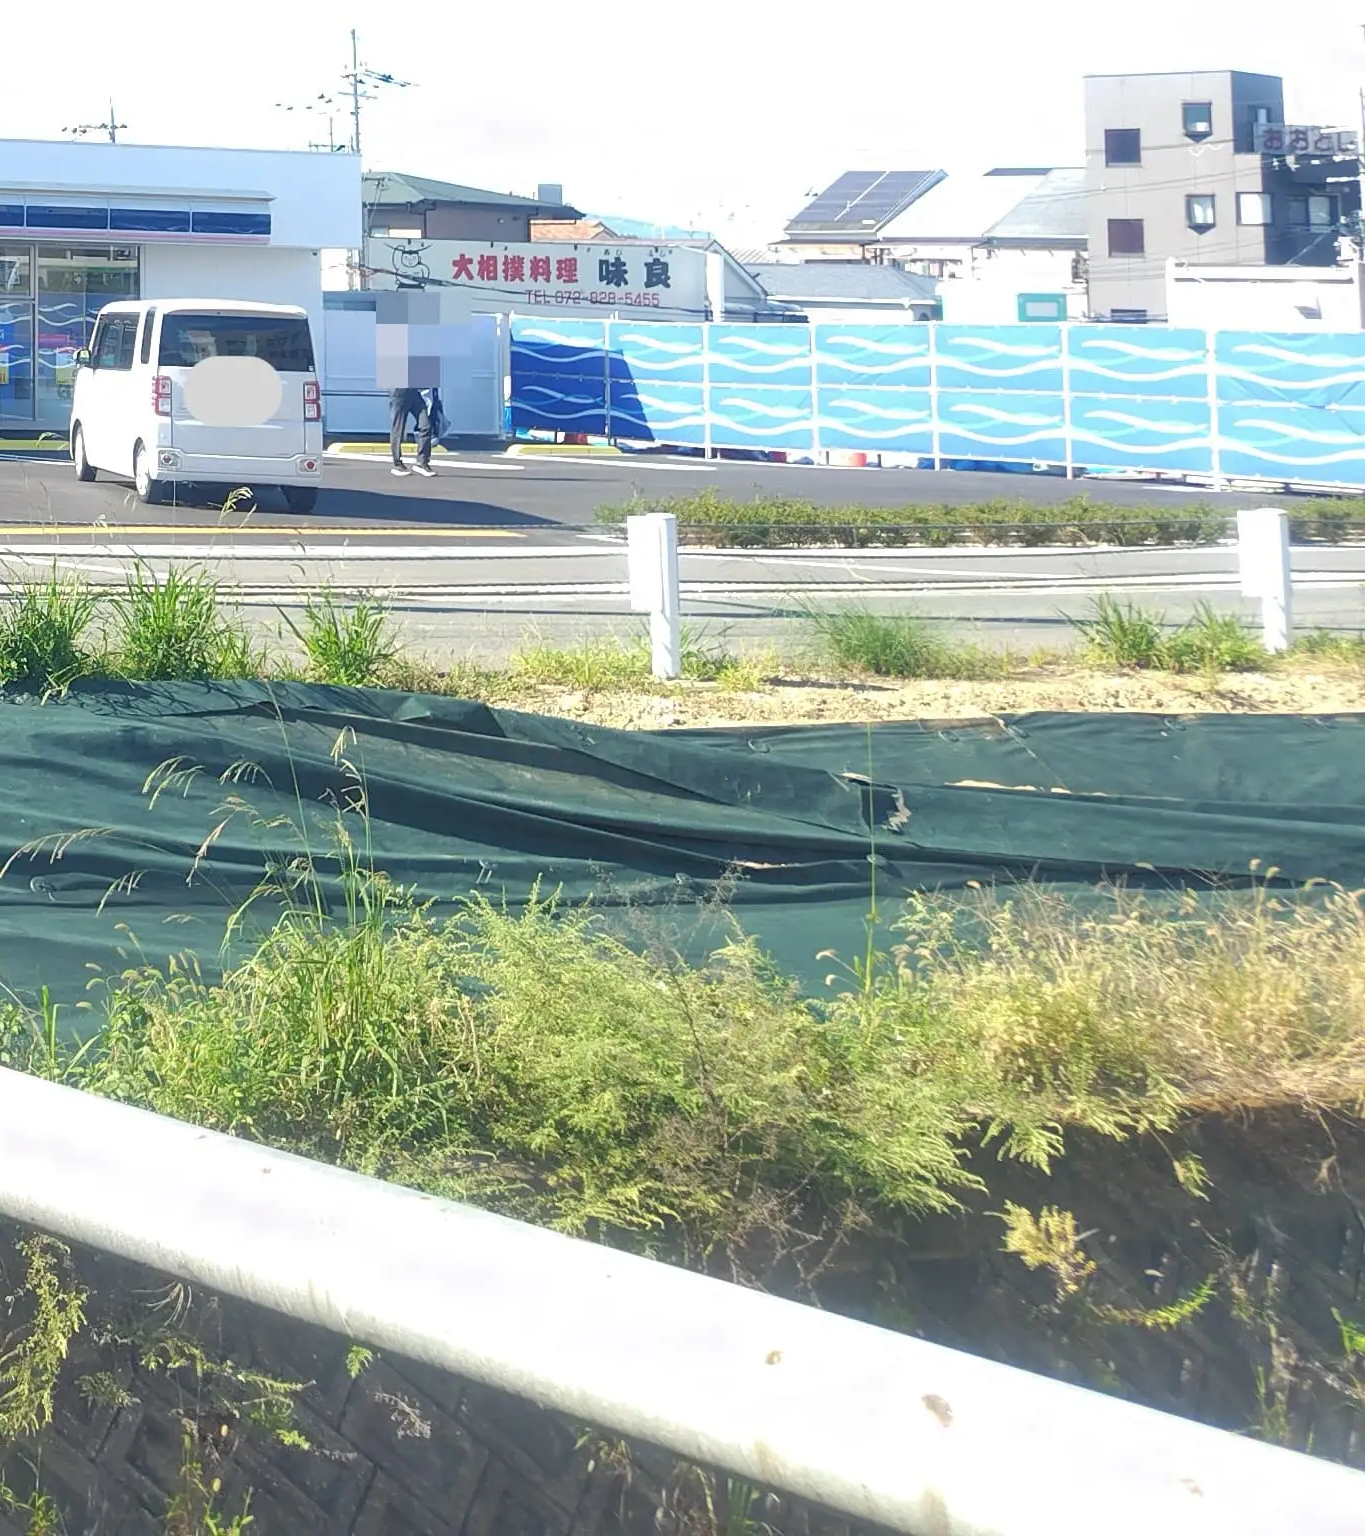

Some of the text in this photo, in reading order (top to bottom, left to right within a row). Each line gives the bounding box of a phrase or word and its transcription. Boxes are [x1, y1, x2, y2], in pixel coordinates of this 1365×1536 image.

[452, 253, 578, 284] 大相撲料理
[525, 289, 550, 305] TEL
